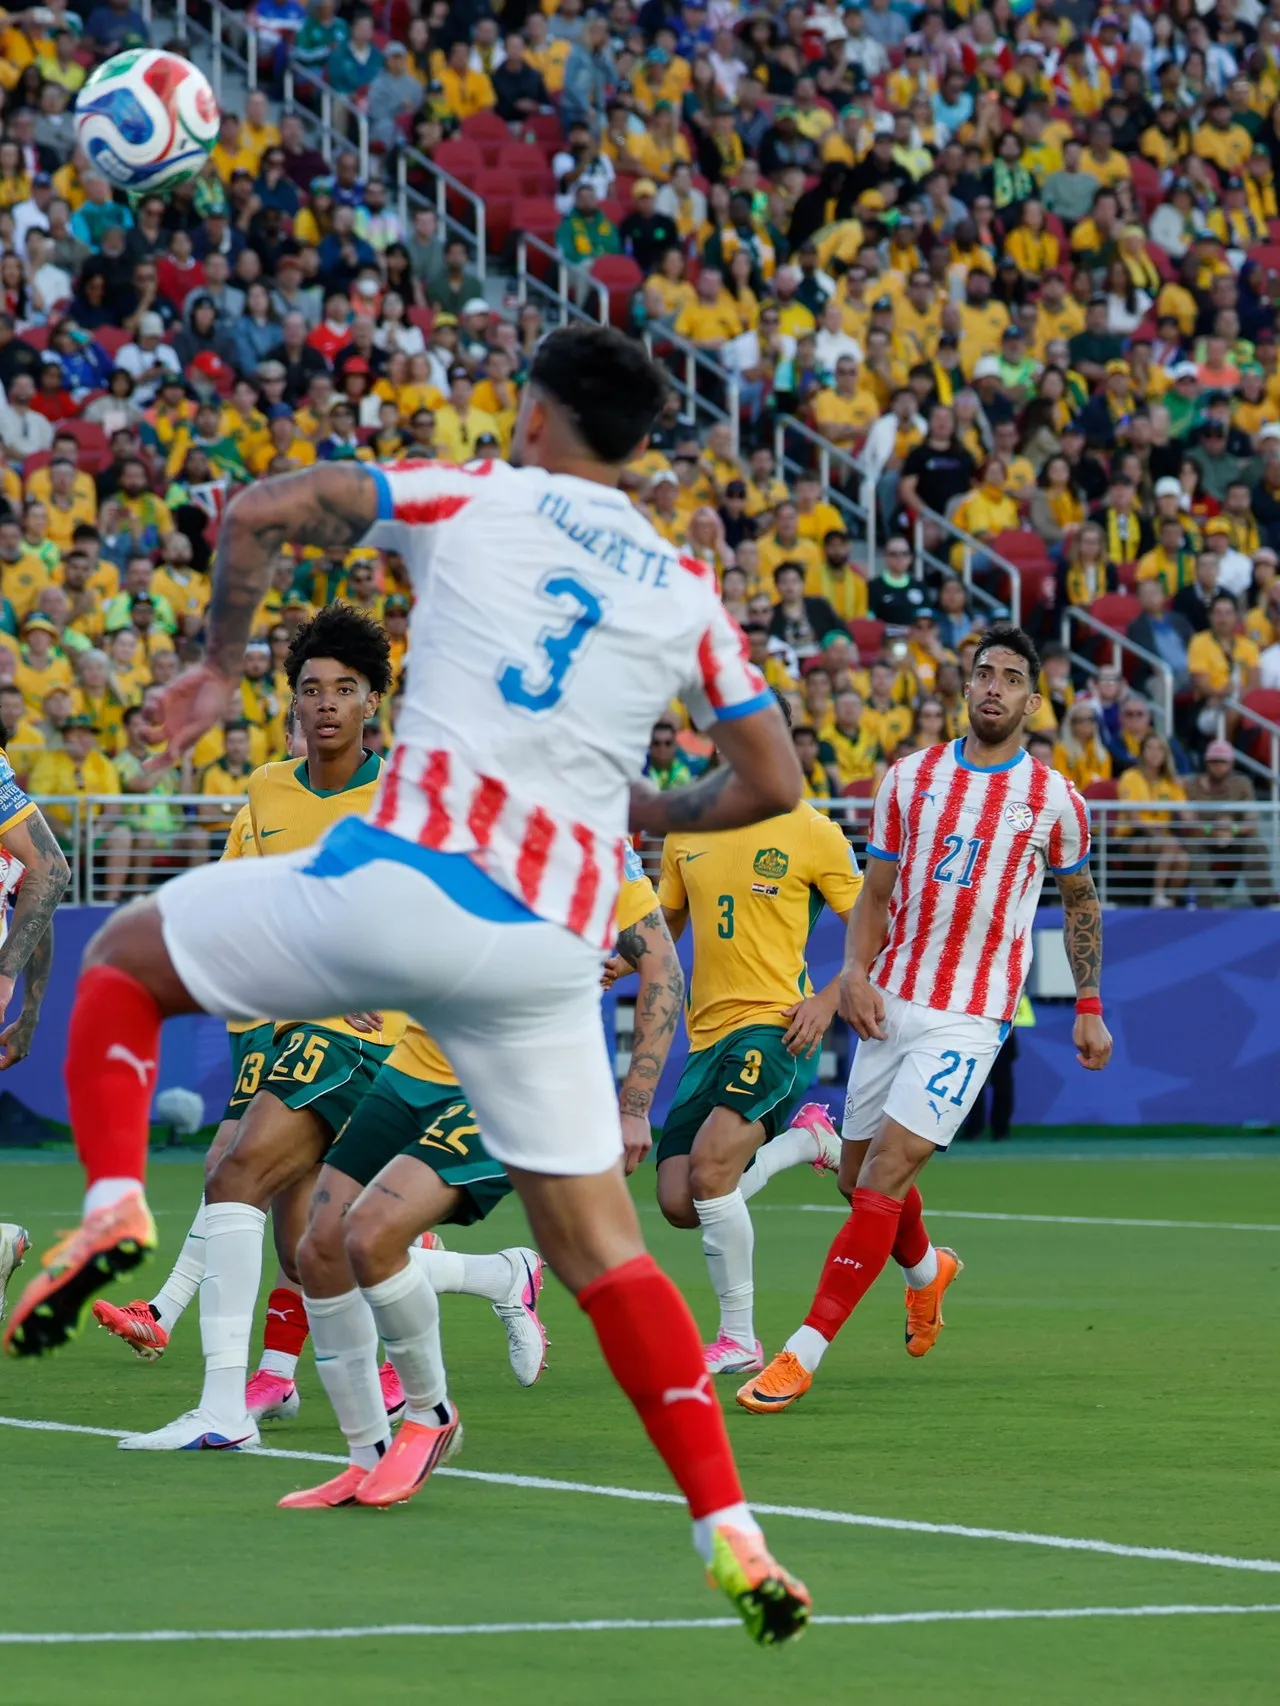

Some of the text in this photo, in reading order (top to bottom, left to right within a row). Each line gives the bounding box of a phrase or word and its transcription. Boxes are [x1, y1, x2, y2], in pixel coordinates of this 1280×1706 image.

[497, 567, 602, 718] 3
[933, 834, 984, 888] 21
[717, 895, 735, 939] 3
[273, 1032, 330, 1083] 25
[739, 1050, 763, 1085] 3
[926, 1050, 977, 1106] 21
[832, 1256, 864, 1270] APF
